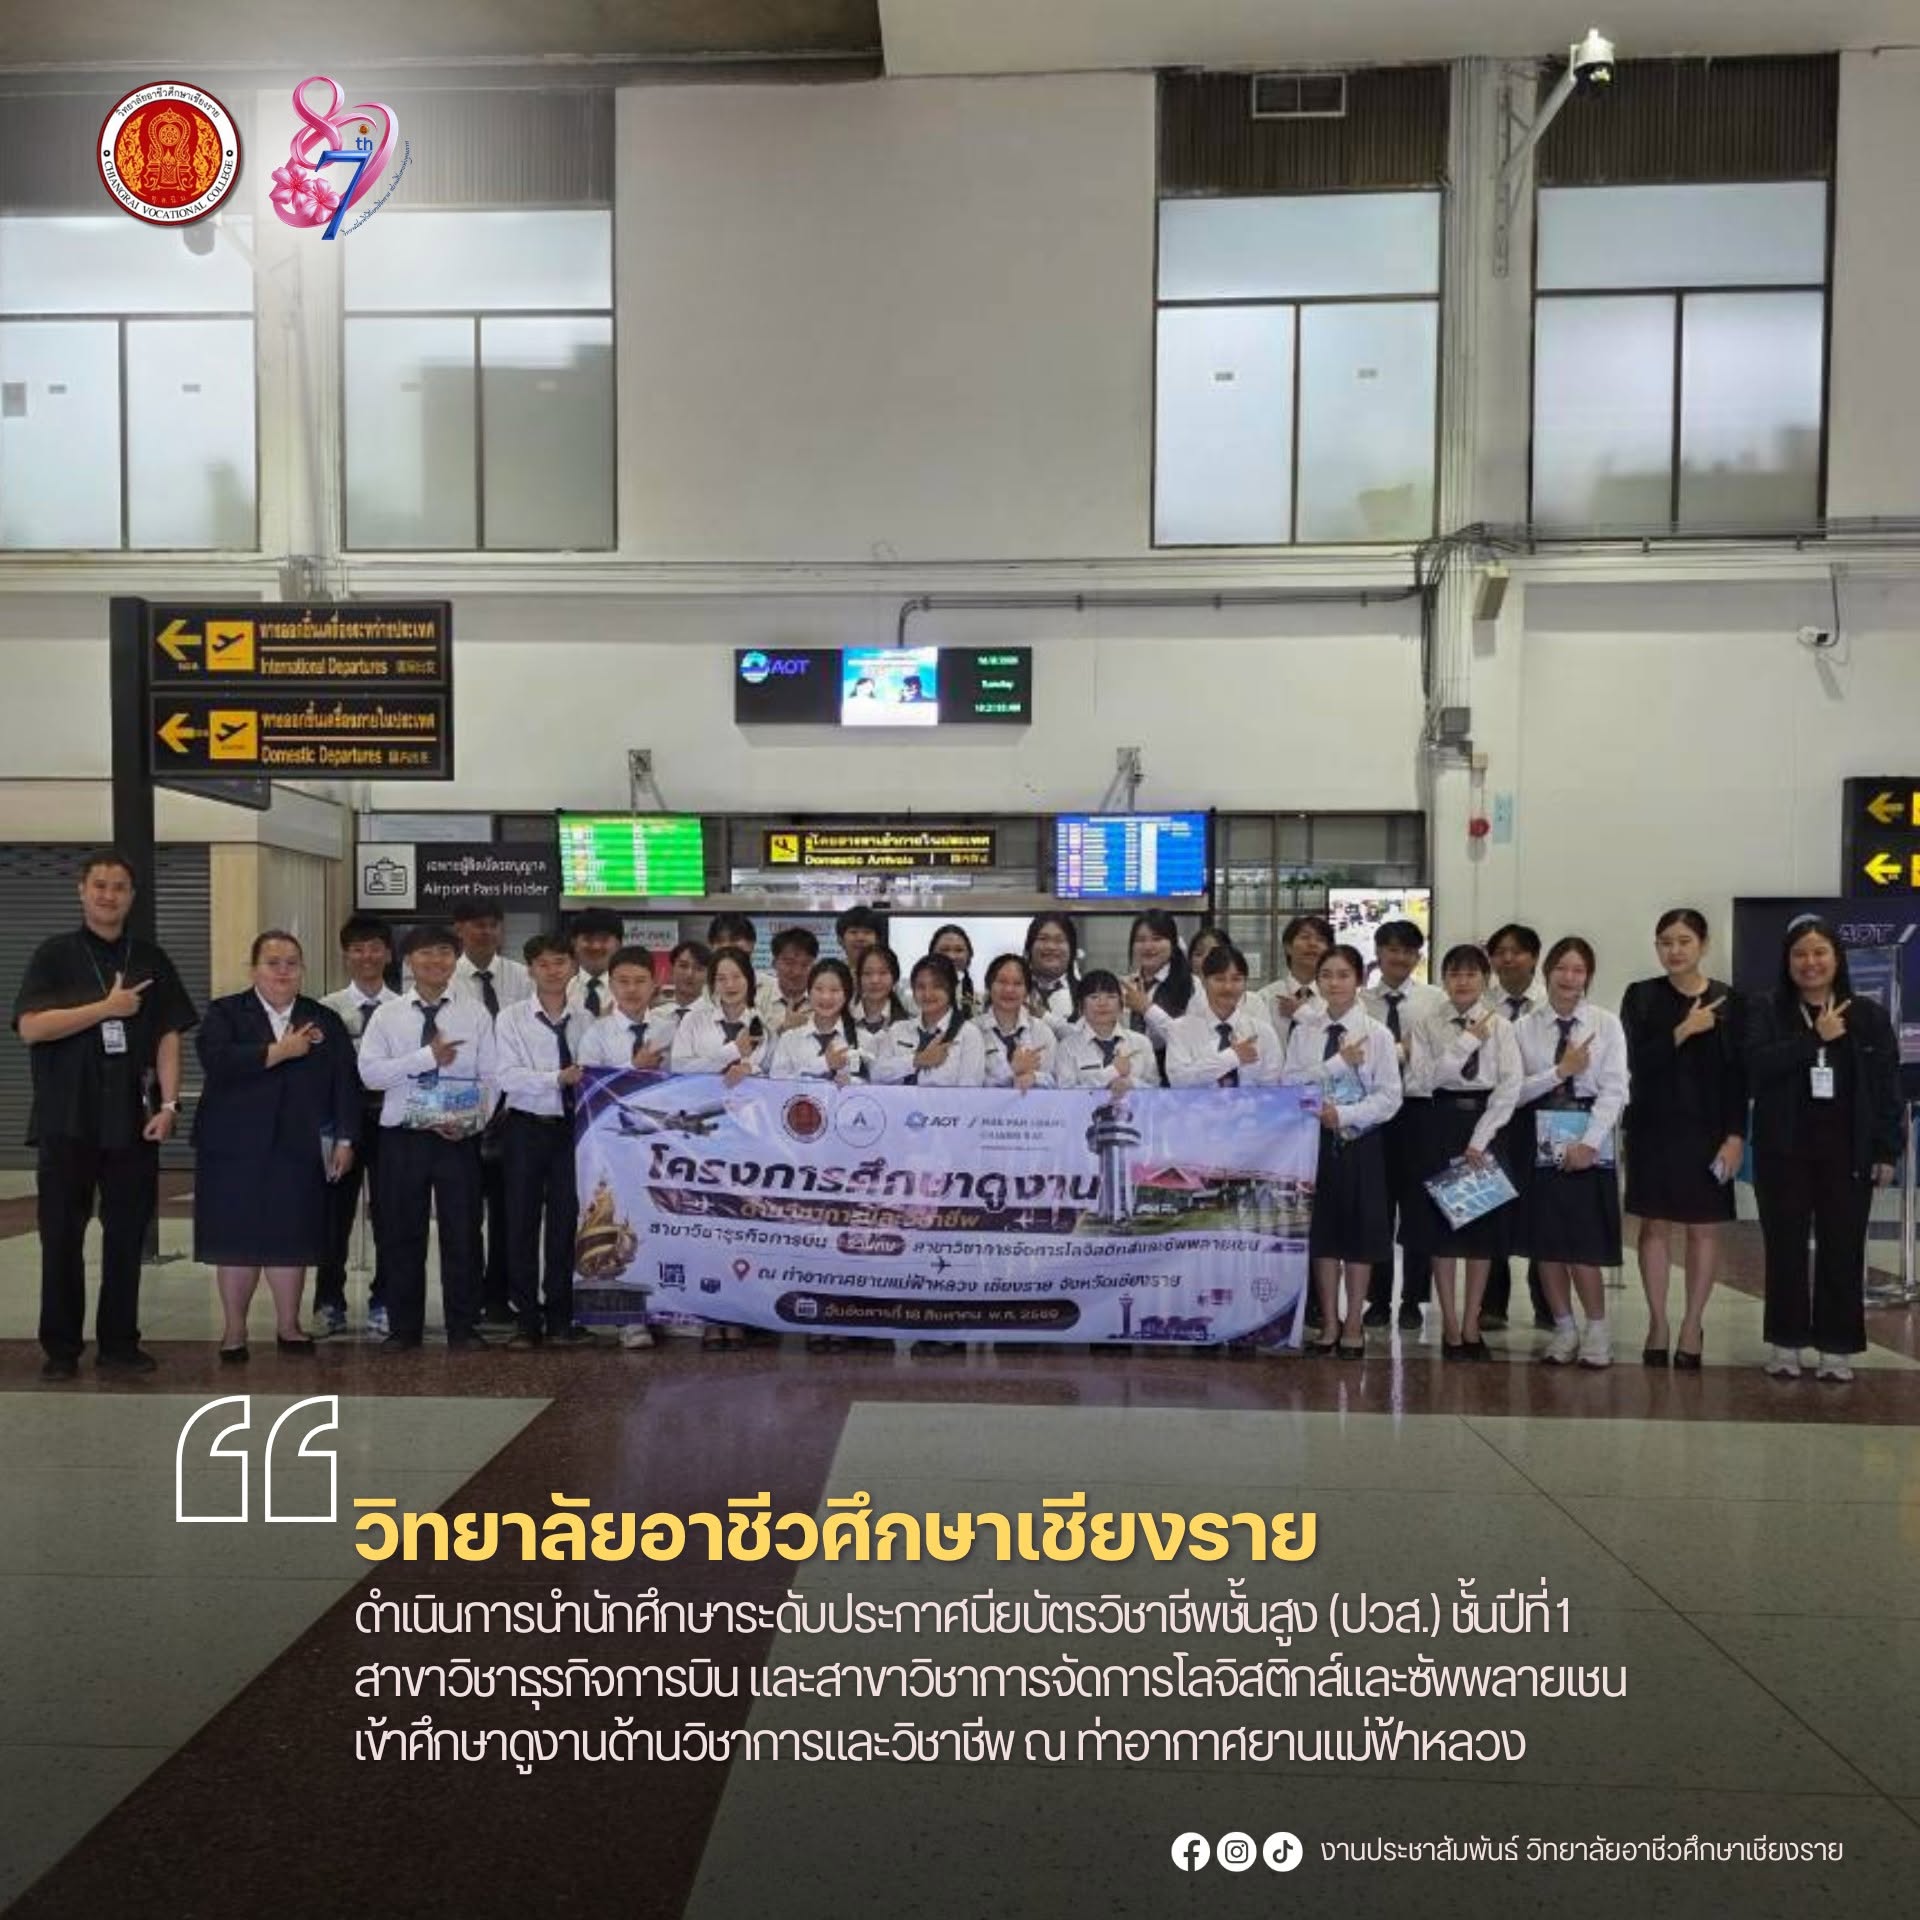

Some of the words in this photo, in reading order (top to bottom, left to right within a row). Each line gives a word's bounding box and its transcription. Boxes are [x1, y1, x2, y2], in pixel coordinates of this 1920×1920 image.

[261, 656, 326, 674] International
[328, 656, 388, 678] Departures
[771, 659, 810, 674] AOT
[261, 745, 316, 764] Domestic
[319, 745, 383, 766] Departures
[424, 883, 470, 899] Airport
[473, 883, 500, 896] Pass
[503, 882, 549, 896] Holder
[649, 1142, 1100, 1213] โครงการศึกษาดูงาน
